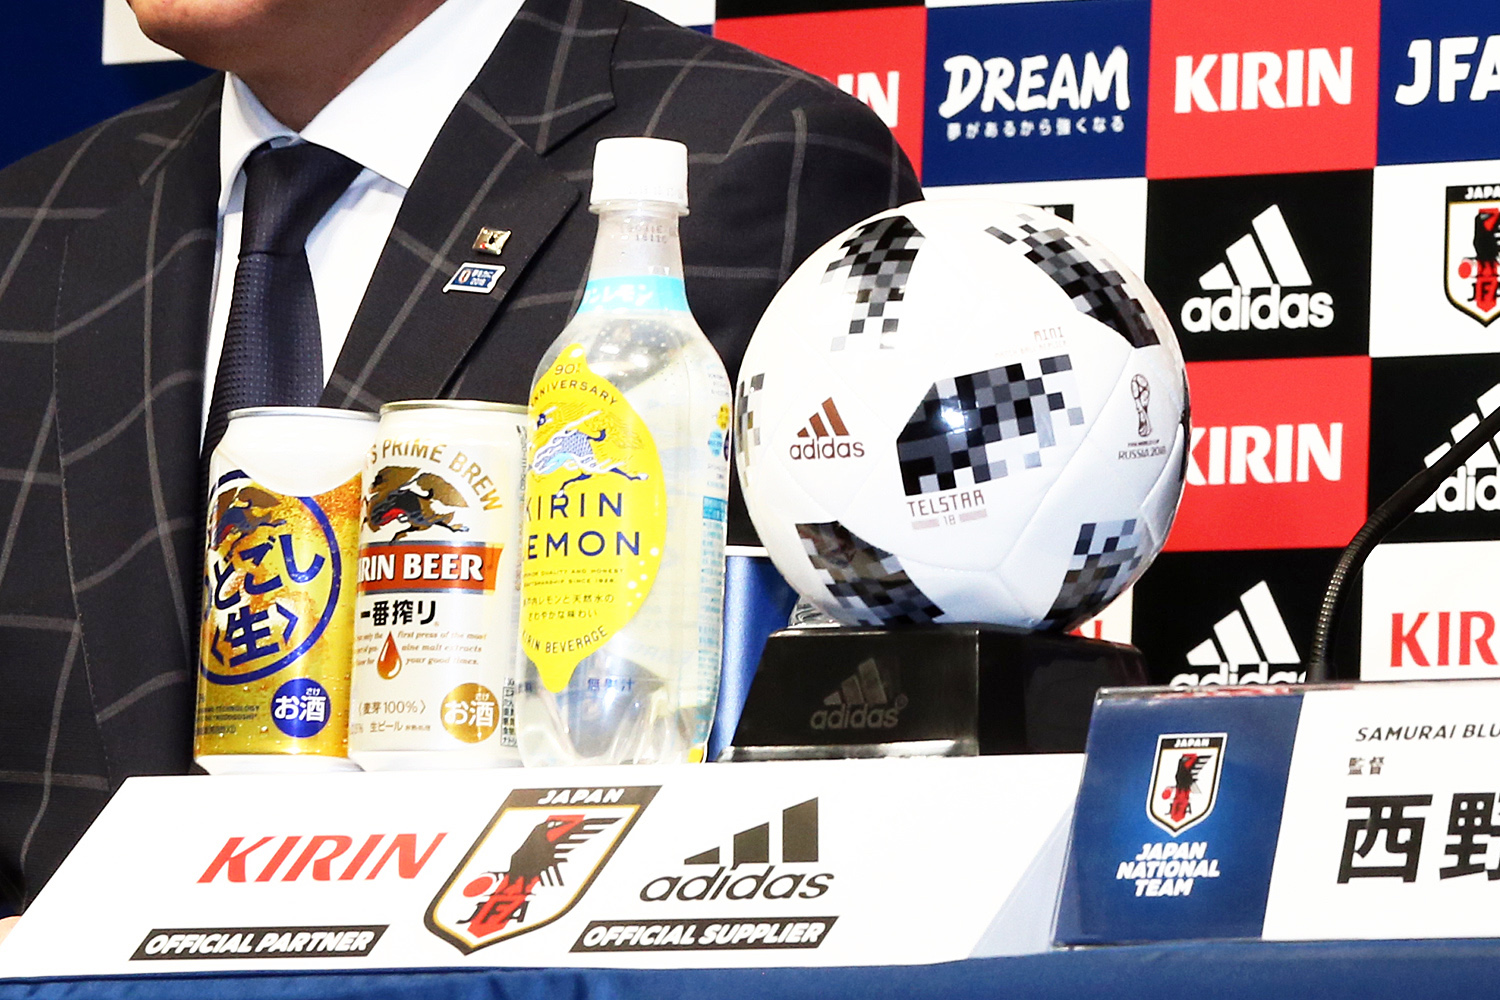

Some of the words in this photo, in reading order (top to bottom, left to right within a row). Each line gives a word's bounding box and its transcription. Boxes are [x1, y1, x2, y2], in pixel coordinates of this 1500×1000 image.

[939, 45, 1130, 118] DREAM
[1175, 47, 1352, 113] KIRIN
[1181, 281, 1333, 333] adidas
[789, 434, 865, 460] adidas
[1118, 447, 1147, 460] RUSSIA
[382, 438, 447, 464] PRIME
[449, 452, 503, 513] BREW
[528, 531, 639, 559] EMON
[206, 534, 326, 610] どごし
[402, 553, 484, 581] BEER
[361, 599, 436, 626] 一番搾り
[545, 624, 608, 654] BEVERAGE
[274, 695, 326, 722] お酒
[444, 700, 495, 727] お酒
[810, 702, 899, 730] adidas
[1174, 737, 1210, 748] JAPAN
[1355, 723, 1457, 742] SAMURAI
[1347, 756, 1385, 776] 監督
[537, 788, 624, 805] JAPAN
[197, 833, 448, 883] KIRIN
[1135, 842, 1208, 861] JAPAN
[639, 860, 835, 901] adidas
[1116, 859, 1221, 880] NATIONAL
[1135, 878, 1195, 898] TEAM
[456, 899, 529, 926] JFA
[144, 931, 254, 956] OFFICIAL
[253, 928, 374, 954] PARTNER
[583, 923, 702, 949] OFFICIAL
[700, 919, 826, 947] SUPPLIER
